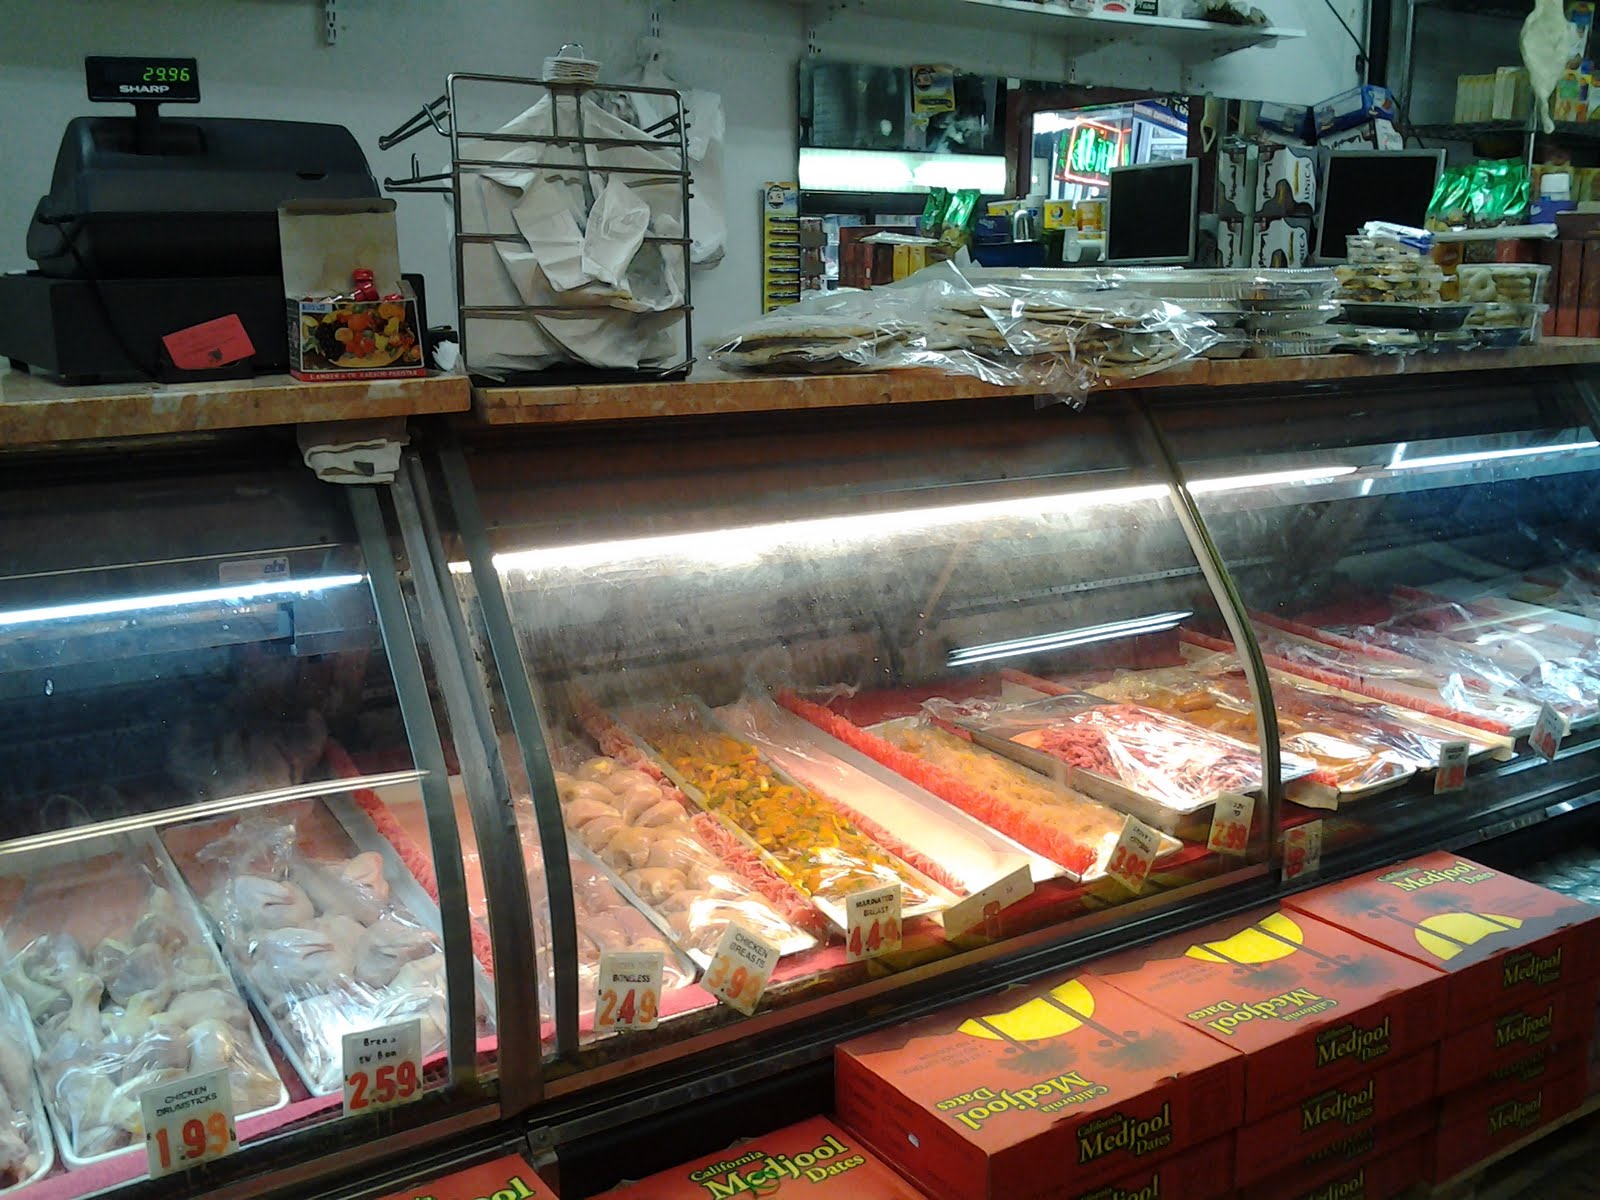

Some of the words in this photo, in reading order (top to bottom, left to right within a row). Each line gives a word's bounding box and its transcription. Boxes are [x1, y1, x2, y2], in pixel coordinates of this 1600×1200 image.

[119, 84, 170, 93] SHARP
[1390, 860, 1479, 892] Medjool
[729, 941, 766, 969] BREASTS
[734, 932, 769, 959] CHICKEN
[1186, 1000, 1239, 1021] Dates
[1207, 987, 1323, 1036] Medjool
[1317, 1014, 1389, 1067] Medjool
[1495, 1005, 1553, 1048] Medjool
[156, 1092, 218, 1117] DRUMSTICKS
[164, 1085, 207, 1104] CHICKEN
[936, 1087, 997, 1111] Dates
[953, 1071, 1094, 1131] Medjool
[1040, 1084, 1109, 1113] California
[1303, 1079, 1374, 1131] Medjool
[1487, 1090, 1542, 1134] Medjool
[1079, 1101, 1171, 1164] Medjool
[1135, 1132, 1172, 1156] Dates
[689, 1150, 766, 1182] California
[701, 1134, 849, 1200] Medjool
[805, 1154, 866, 1184] Dates
